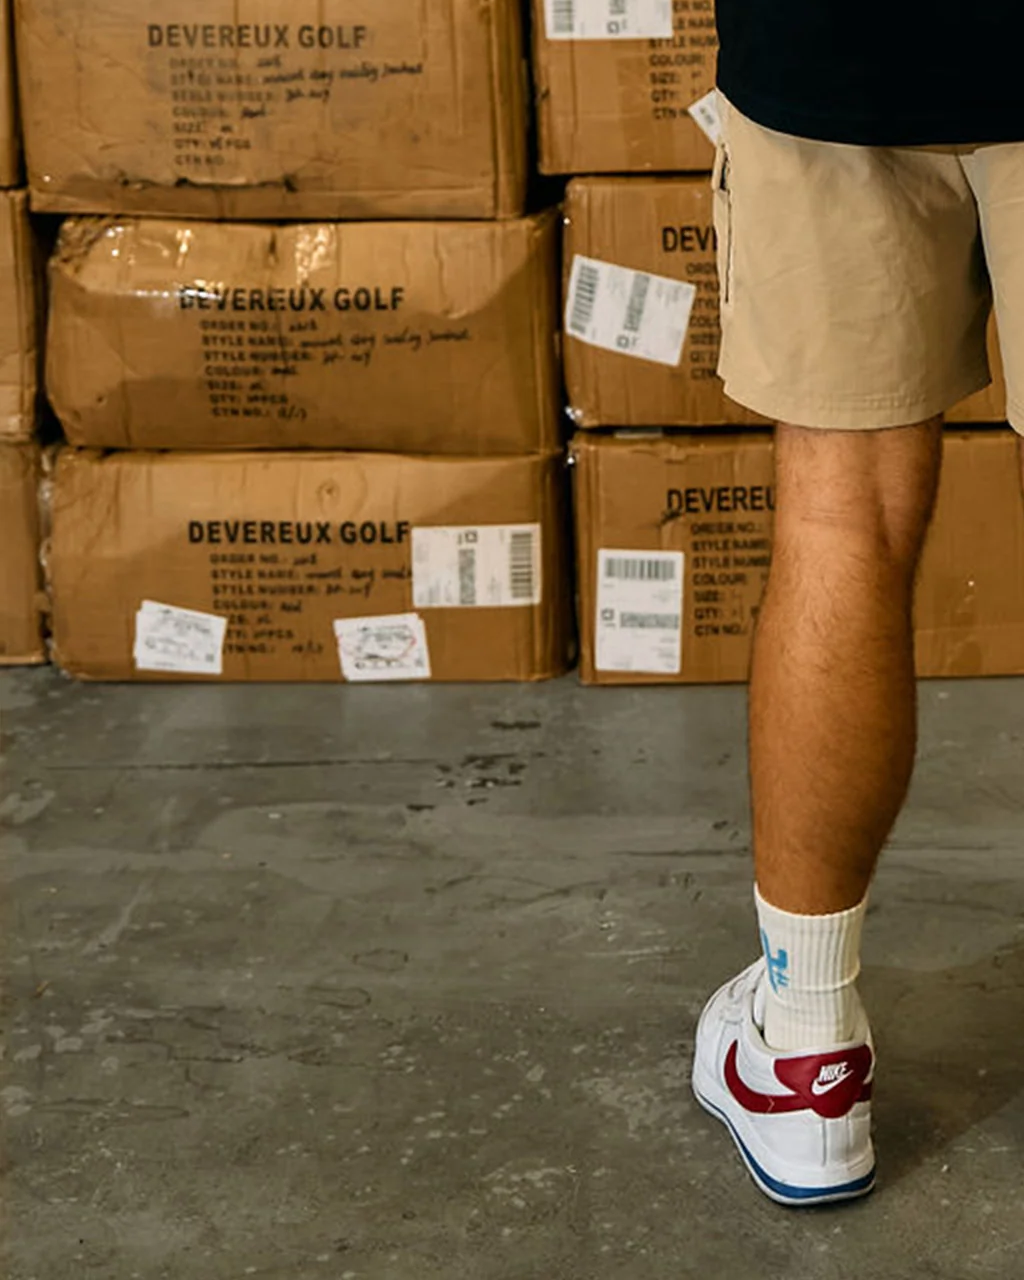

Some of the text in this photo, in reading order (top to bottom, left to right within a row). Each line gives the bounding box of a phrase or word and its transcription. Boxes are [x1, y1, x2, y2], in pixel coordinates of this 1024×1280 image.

[147, 23, 367, 48] DEVEREUX GOLF
[180, 286, 405, 311] DEVEREUX GOLF
[188, 520, 411, 545] DEVEREUX GOLF
